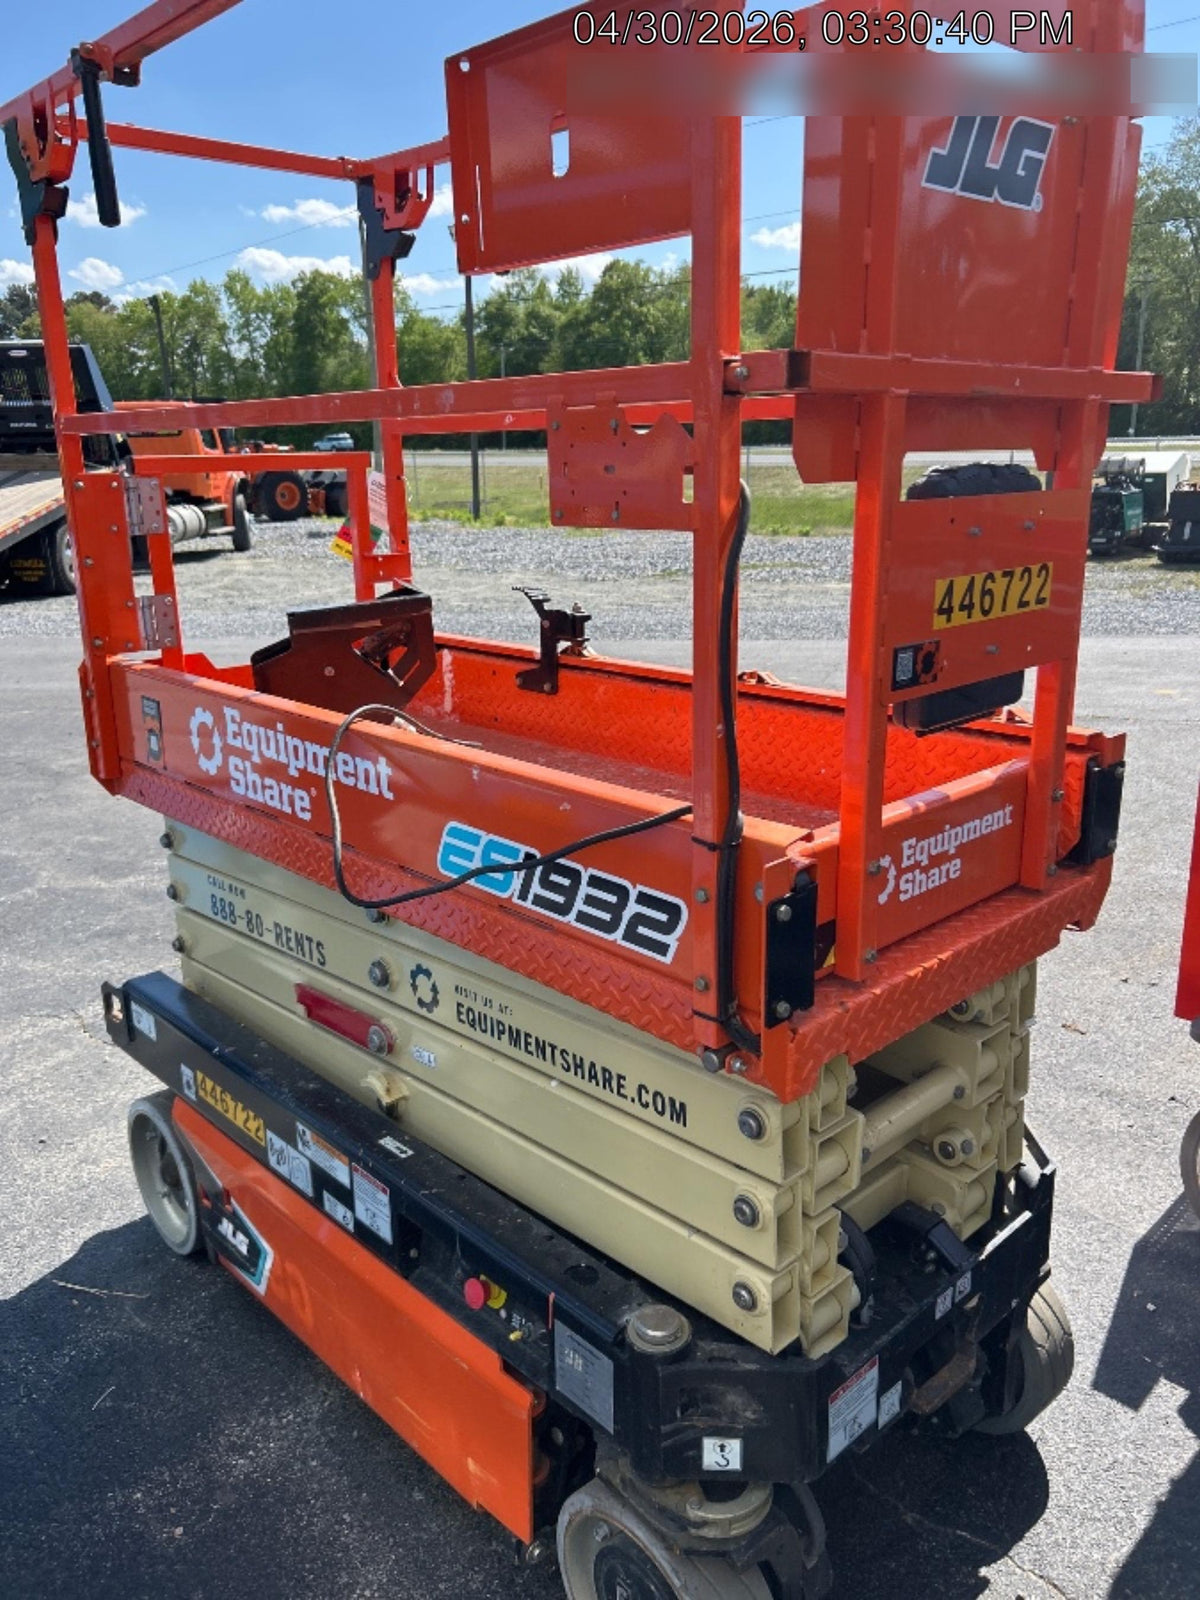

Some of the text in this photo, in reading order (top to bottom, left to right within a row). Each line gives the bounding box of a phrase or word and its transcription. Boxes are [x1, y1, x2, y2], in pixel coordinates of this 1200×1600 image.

[922, 115, 1055, 212] JLG
[935, 562, 1051, 624] 446722
[222, 705, 395, 800] Equipment
[228, 754, 313, 822] Share
[901, 802, 1014, 869] Equipment
[436, 820, 690, 965] ES1932
[899, 857, 962, 902] Share
[211, 896, 326, 966] 888-80-RENTS
[455, 1002, 688, 1128] EQUIPMENTSHARE.COM
[200, 1073, 264, 1144] 446722
